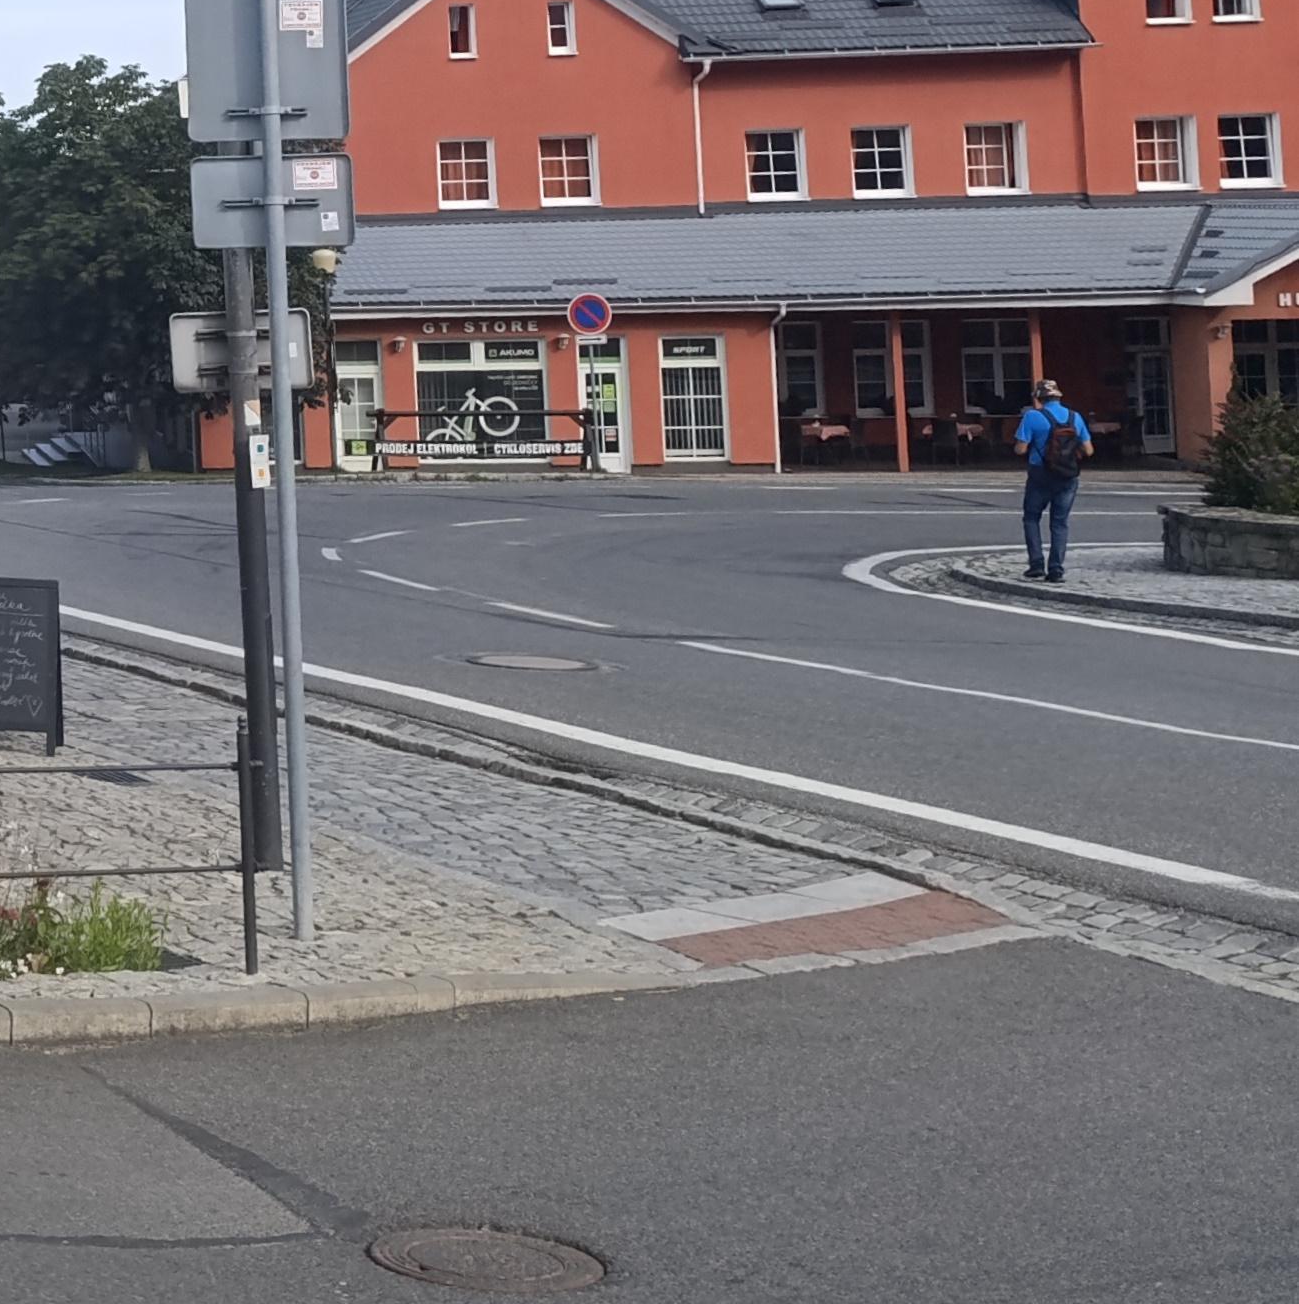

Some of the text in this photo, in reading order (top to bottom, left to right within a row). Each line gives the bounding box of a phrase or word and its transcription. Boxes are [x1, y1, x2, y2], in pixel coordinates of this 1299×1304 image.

[422, 319, 539, 335] GT STORE
[375, 441, 585, 455] PRODEJ ELEKTROKOL CYKLOSERVIS ZDE
